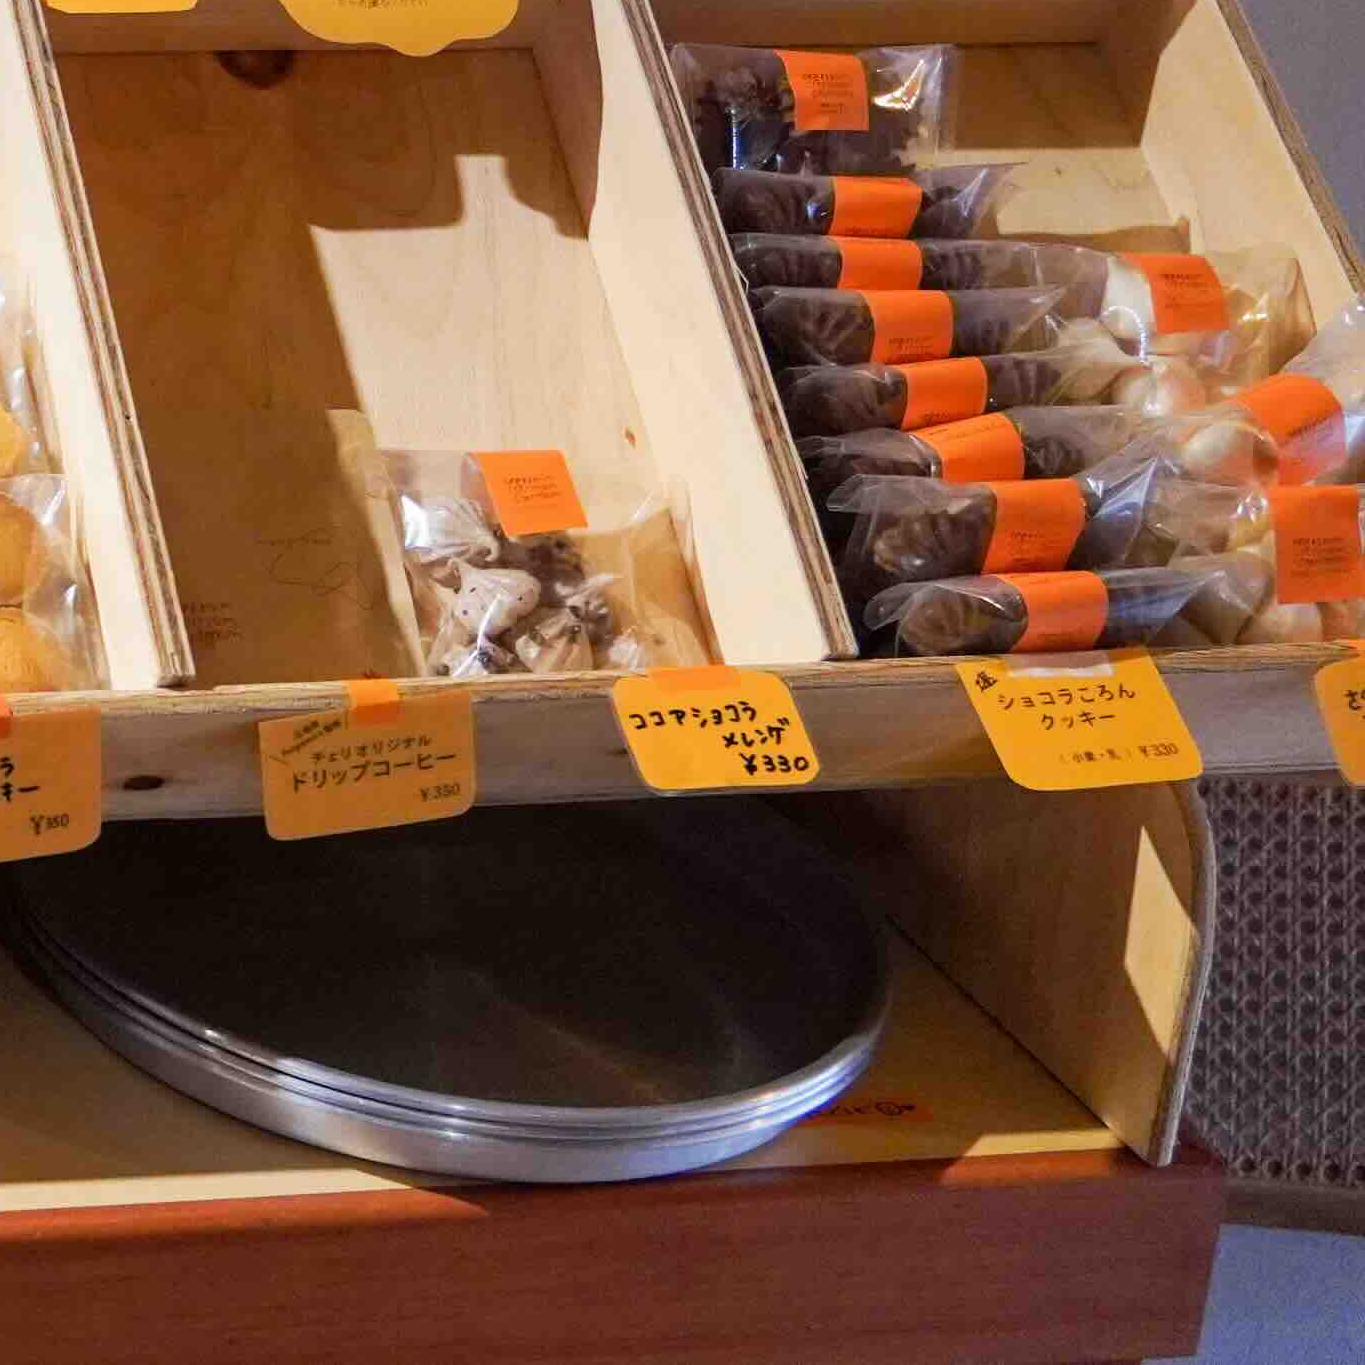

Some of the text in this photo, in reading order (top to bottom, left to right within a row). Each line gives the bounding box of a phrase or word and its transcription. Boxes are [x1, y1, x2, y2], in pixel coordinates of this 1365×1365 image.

[997, 683, 1137, 711] ショコラころん
[628, 700, 758, 730] ココアショコラ
[1040, 711, 1117, 731] クッキー
[721, 716, 791, 749] メレンゲ
[292, 752, 457, 794] ドリップコーヒー
[738, 751, 810, 776] ¥330
